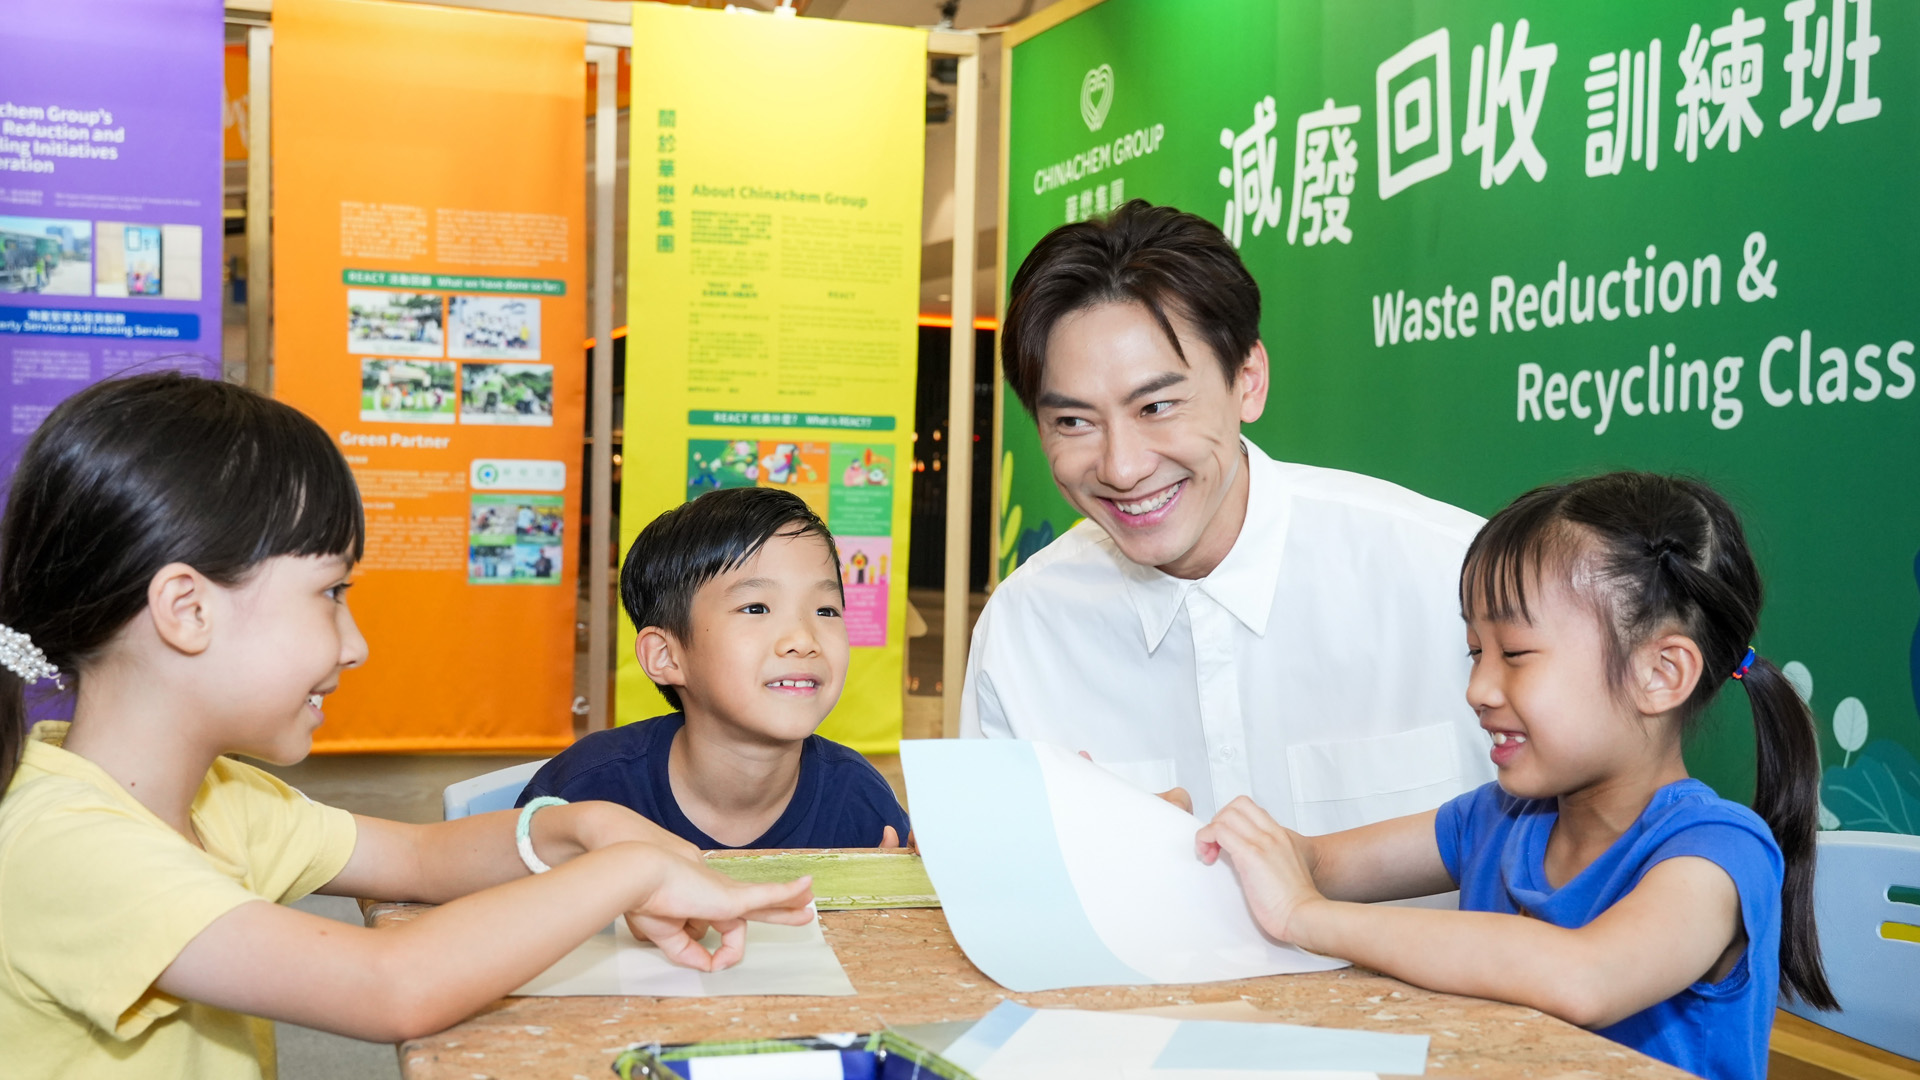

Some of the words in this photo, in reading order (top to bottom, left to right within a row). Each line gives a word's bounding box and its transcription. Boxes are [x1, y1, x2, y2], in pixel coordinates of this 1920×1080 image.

[46, 105, 113, 128] Group's
[2, 119, 90, 141] Reduction
[92, 126, 125, 143] and
[33, 139, 119, 160] Initiatives
[1034, 143, 1111, 195] CHINACHEM
[1113, 123, 1165, 166] GROUP
[657, 109, 676, 253] 關於華懋集團
[692, 184, 735, 198] About
[739, 186, 821, 203] Chinachem
[824, 192, 868, 209] Group
[348, 271, 385, 283] REACT
[437, 277, 463, 288] What
[464, 280, 479, 289] we
[480, 279, 504, 290] have
[504, 280, 529, 291] done
[530, 283, 542, 292] so
[1372, 285, 1479, 348] Waste
[1489, 244, 1722, 335] Reduction
[1736, 231, 1778, 303] &
[23, 320, 69, 333] Services
[70, 323, 91, 334] and
[93, 325, 133, 338] Leasing
[134, 326, 179, 338] Services
[1516, 342, 1744, 436] Recycling
[1759, 329, 1917, 408] Class
[713, 412, 747, 423] REACT
[806, 415, 830, 426] What
[838, 416, 872, 428] REACT?
[340, 431, 387, 447] Green
[390, 433, 450, 449] Partner
